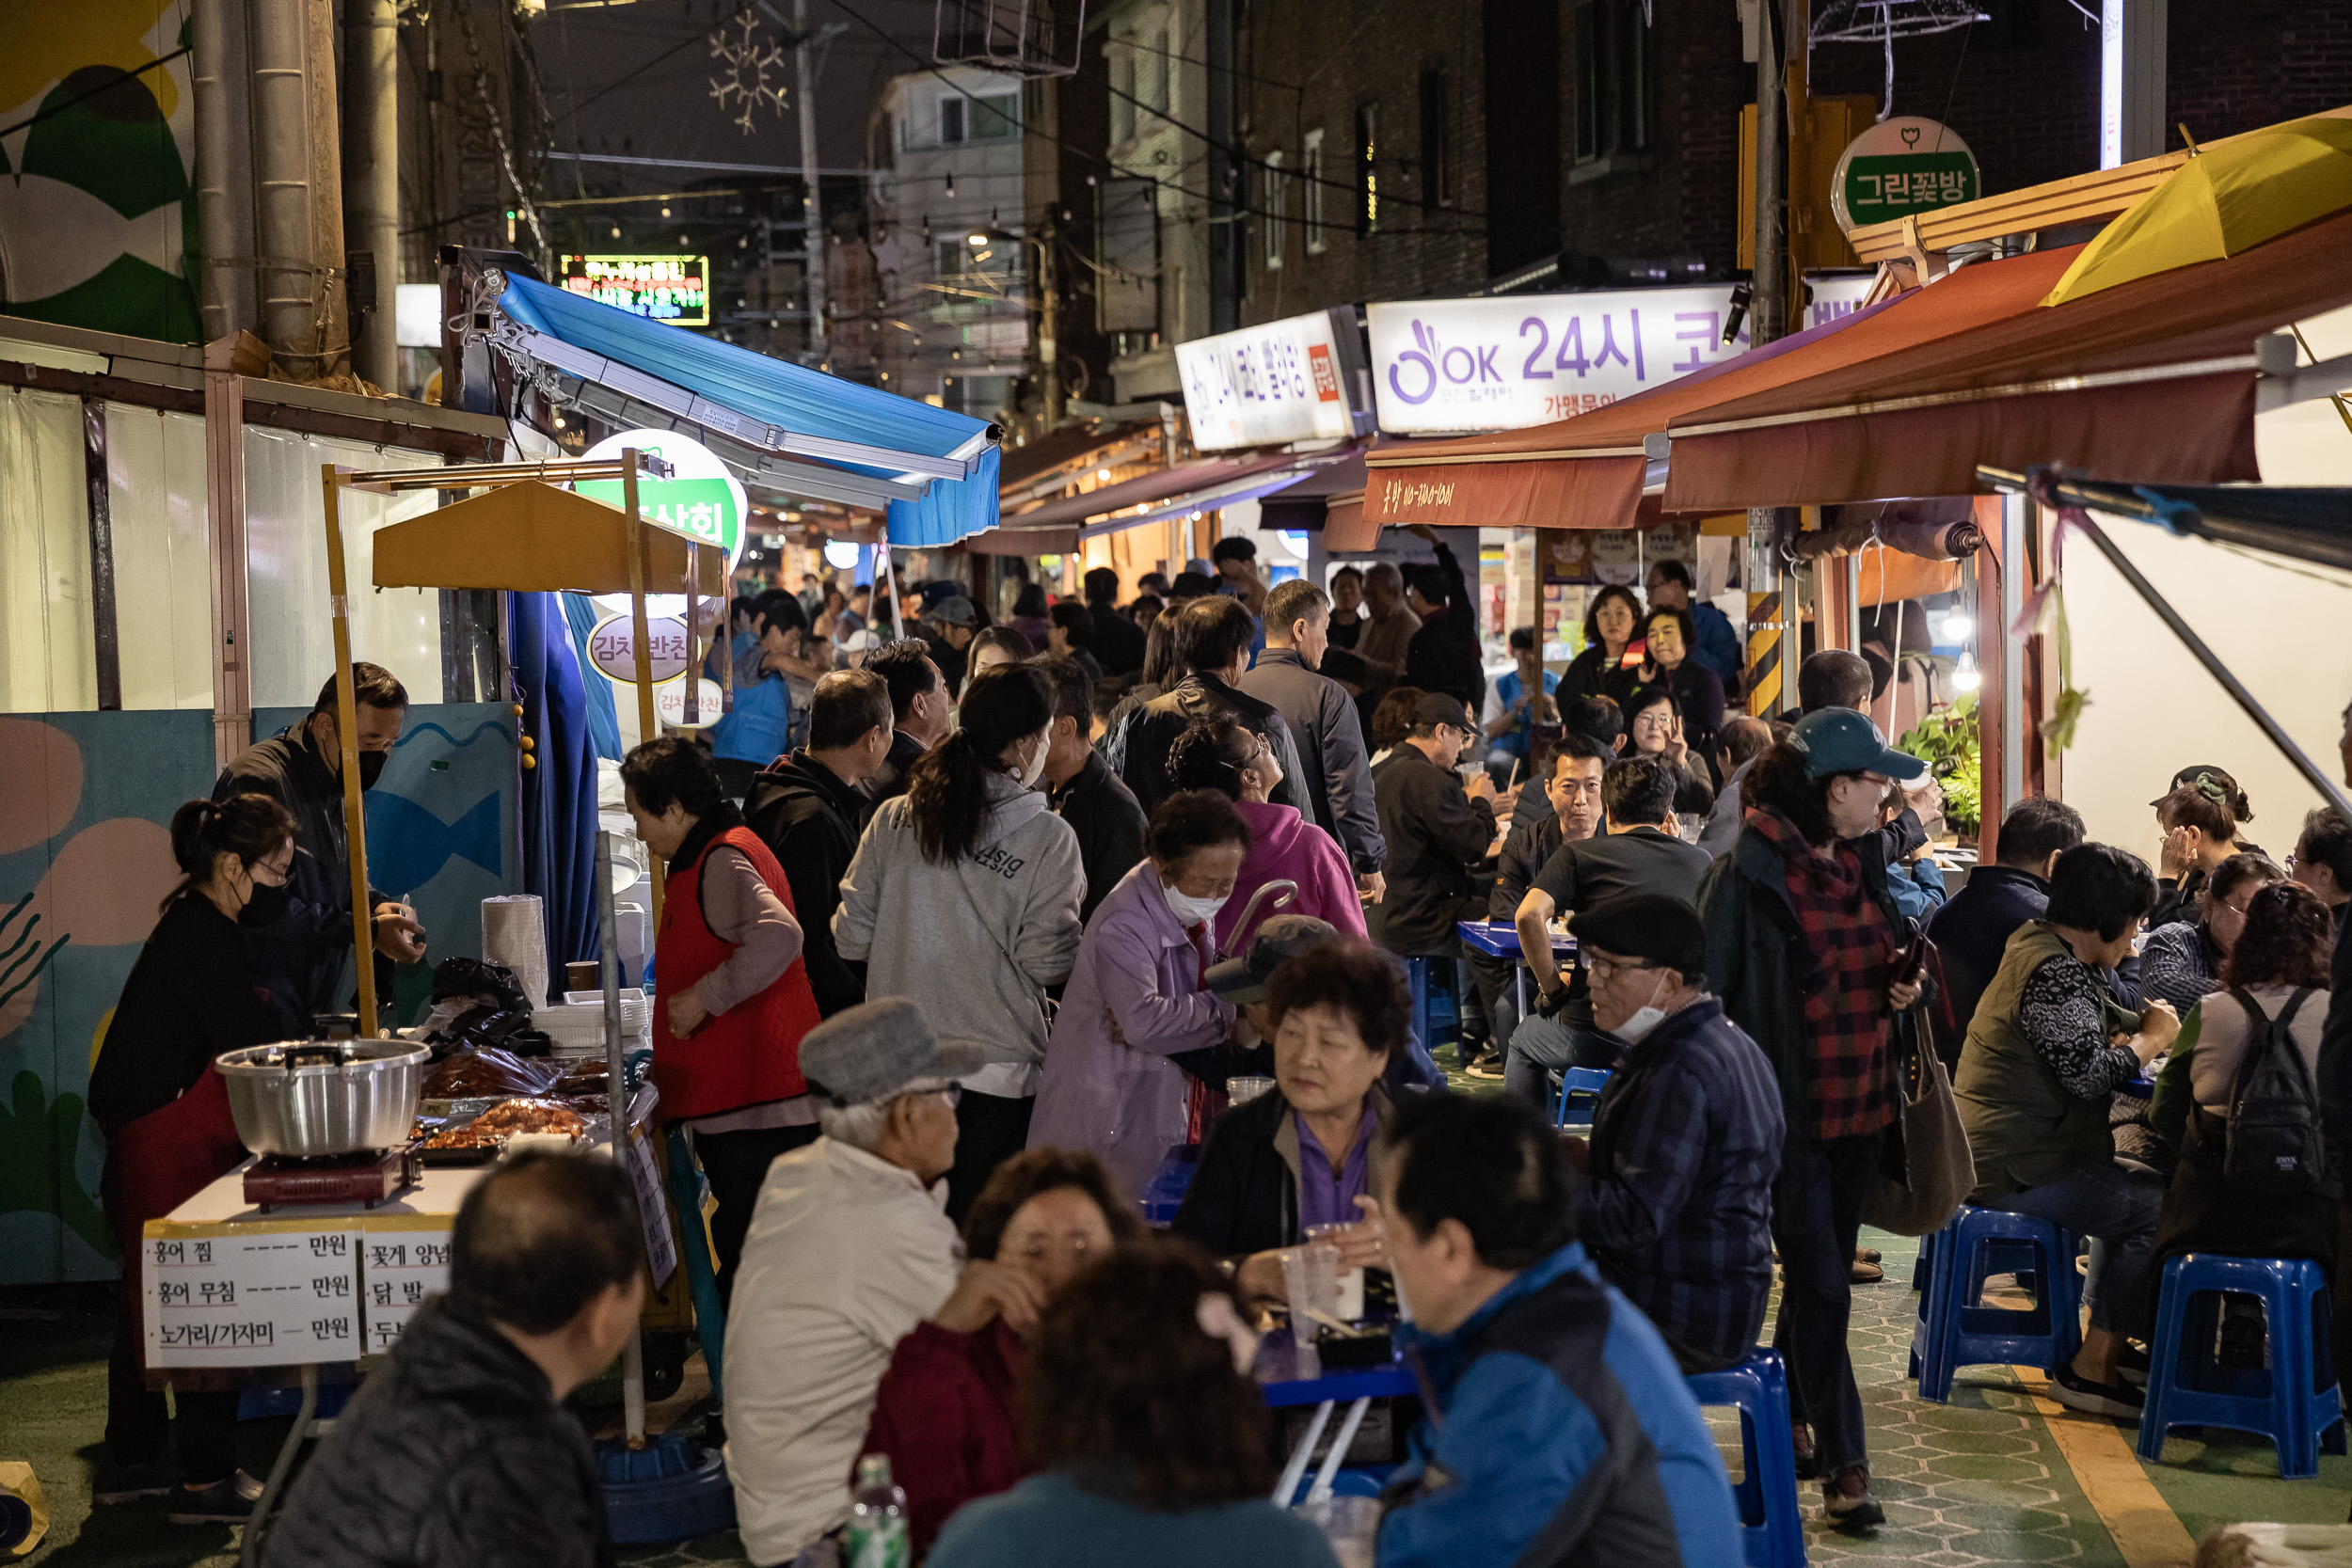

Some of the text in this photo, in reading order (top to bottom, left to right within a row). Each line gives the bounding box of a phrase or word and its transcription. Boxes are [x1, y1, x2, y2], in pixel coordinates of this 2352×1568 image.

[1856, 170, 1967, 205] 그린꽃방
[1518, 309, 1645, 383] 24시
[1673, 311, 1751, 372] 코
[1441, 344, 1502, 384] OK
[594, 635, 636, 661] 김치
[154, 1234, 347, 1264] 홍어 찜 만원
[371, 1244, 406, 1267] 꽃게
[157, 1275, 350, 1305] 홍어 무침 만원
[372, 1280, 424, 1305] 닭 발
[160, 1317, 349, 1346] 노가리/가자미 만원
